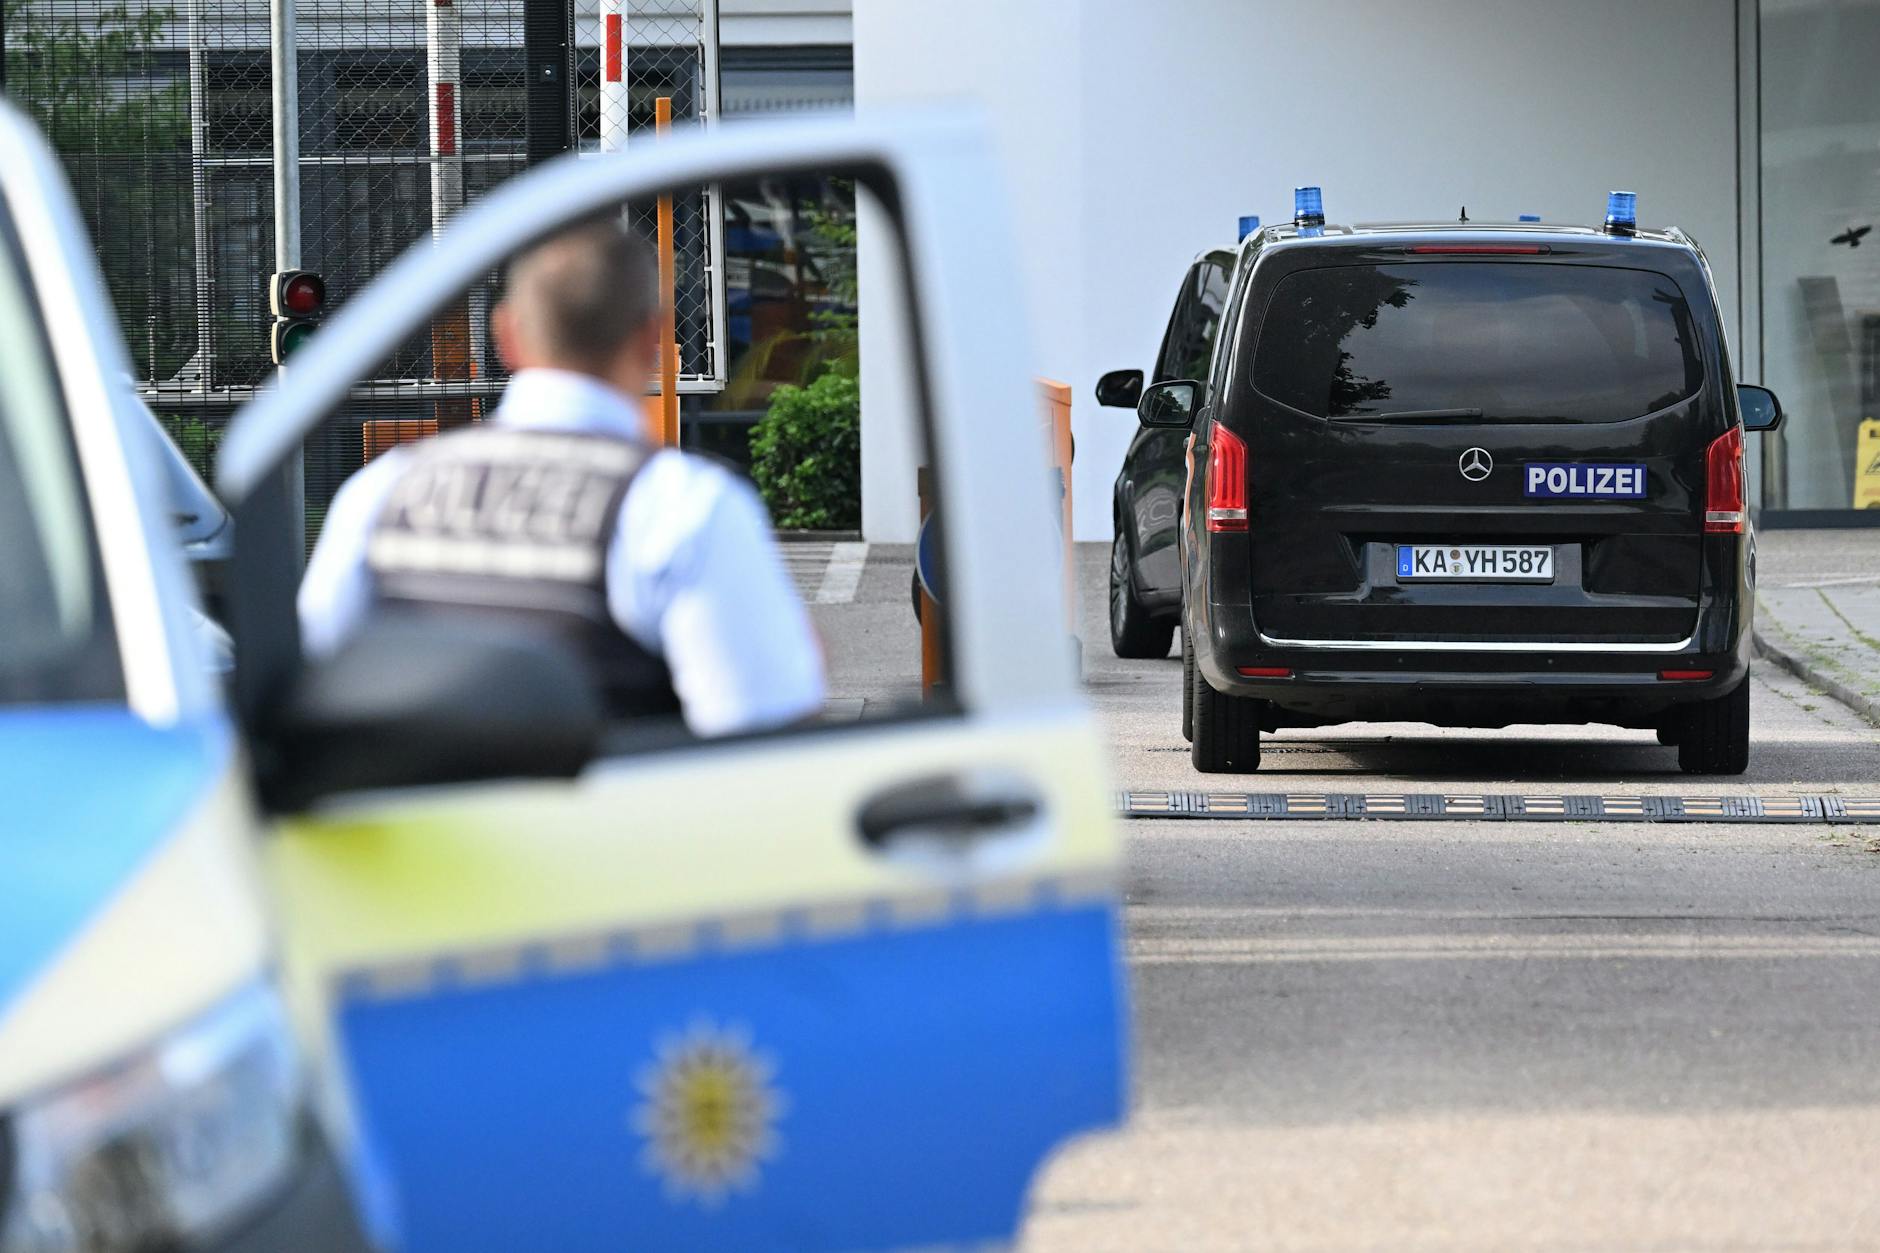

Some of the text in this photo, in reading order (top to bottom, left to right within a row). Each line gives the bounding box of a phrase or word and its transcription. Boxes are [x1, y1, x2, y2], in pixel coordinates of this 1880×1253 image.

[1528, 467, 1642, 494] POLIZEI
[1402, 564, 1409, 572] D
[1415, 550, 1447, 573] KA
